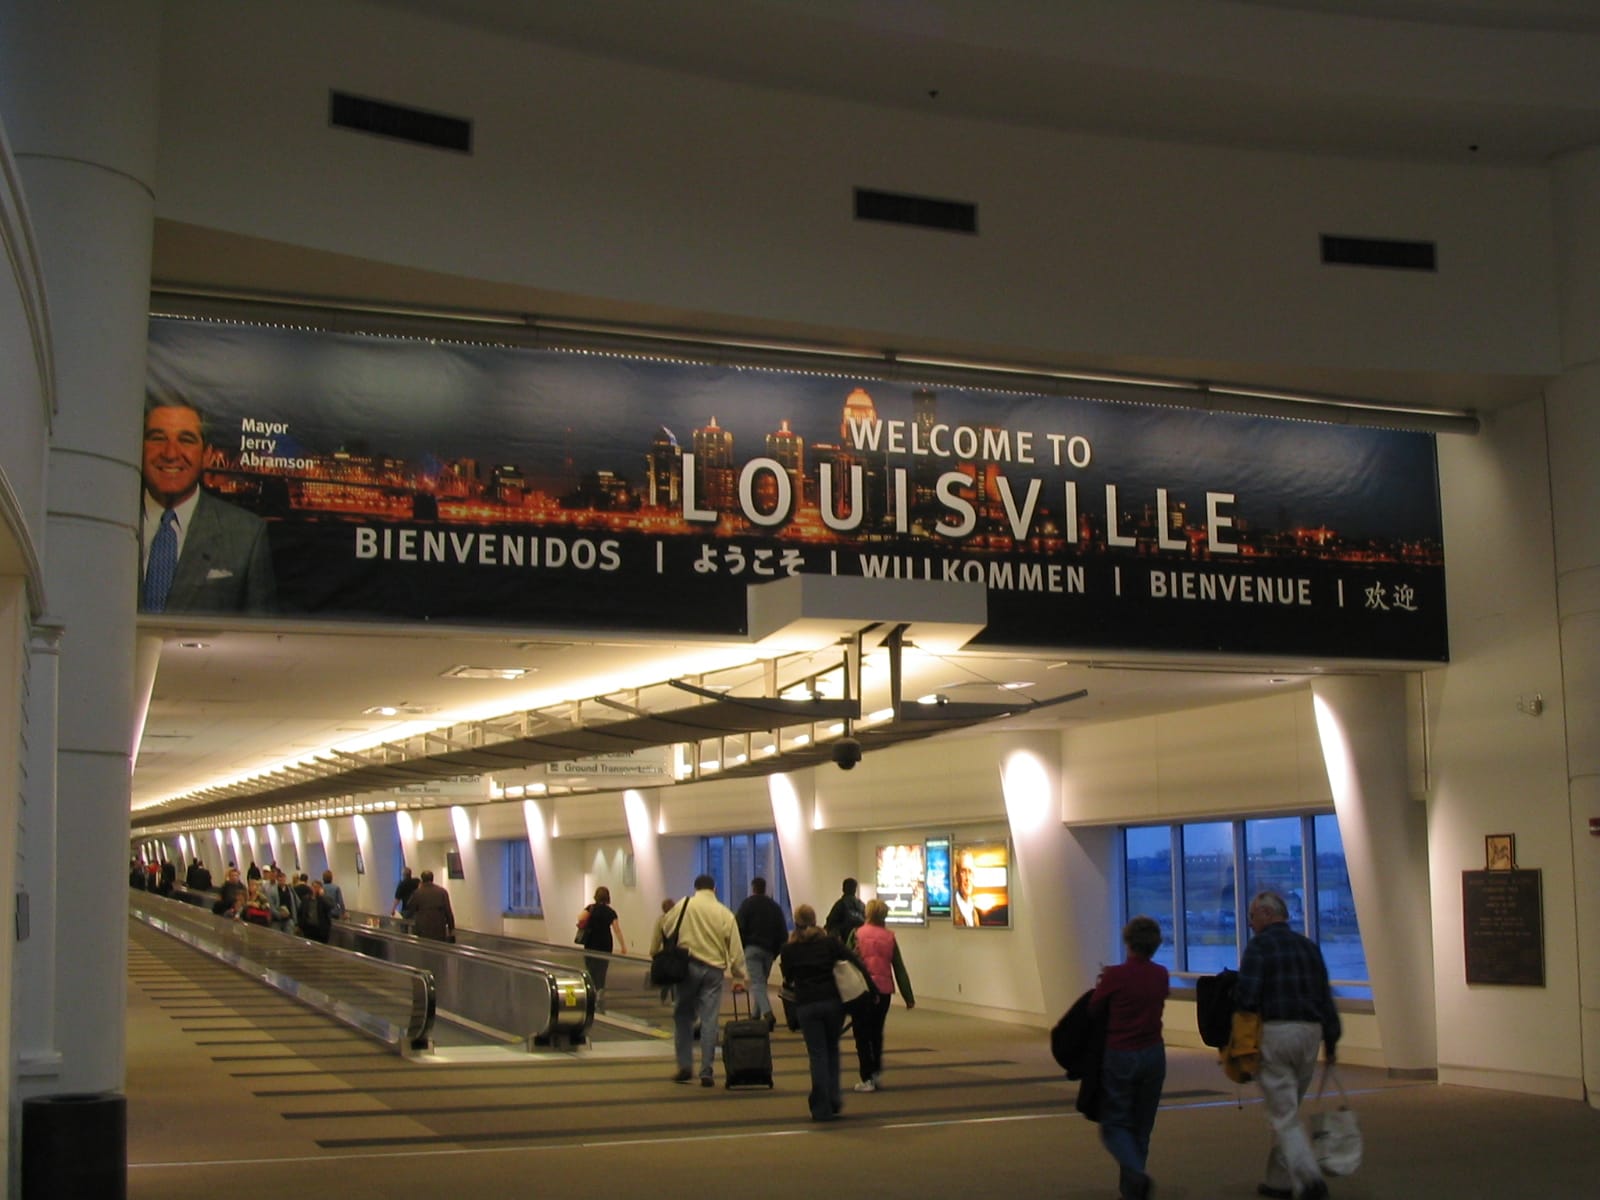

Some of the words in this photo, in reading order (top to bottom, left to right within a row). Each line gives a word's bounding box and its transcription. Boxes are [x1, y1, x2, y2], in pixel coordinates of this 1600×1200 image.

[242, 418, 289, 437] Mayor
[849, 417, 1035, 464] WELCOME
[1047, 434, 1092, 469] TO
[240, 435, 276, 454] Jerry
[240, 452, 314, 470] Abramson
[682, 452, 1239, 555] LOUISVILLE
[354, 526, 622, 572] BIENVENIDOS
[693, 543, 805, 577] ようこそ
[1150, 570, 1312, 606] BIENVENUE
[1364, 580, 1418, 612] 欢迎
[564, 762, 598, 773] Ground
